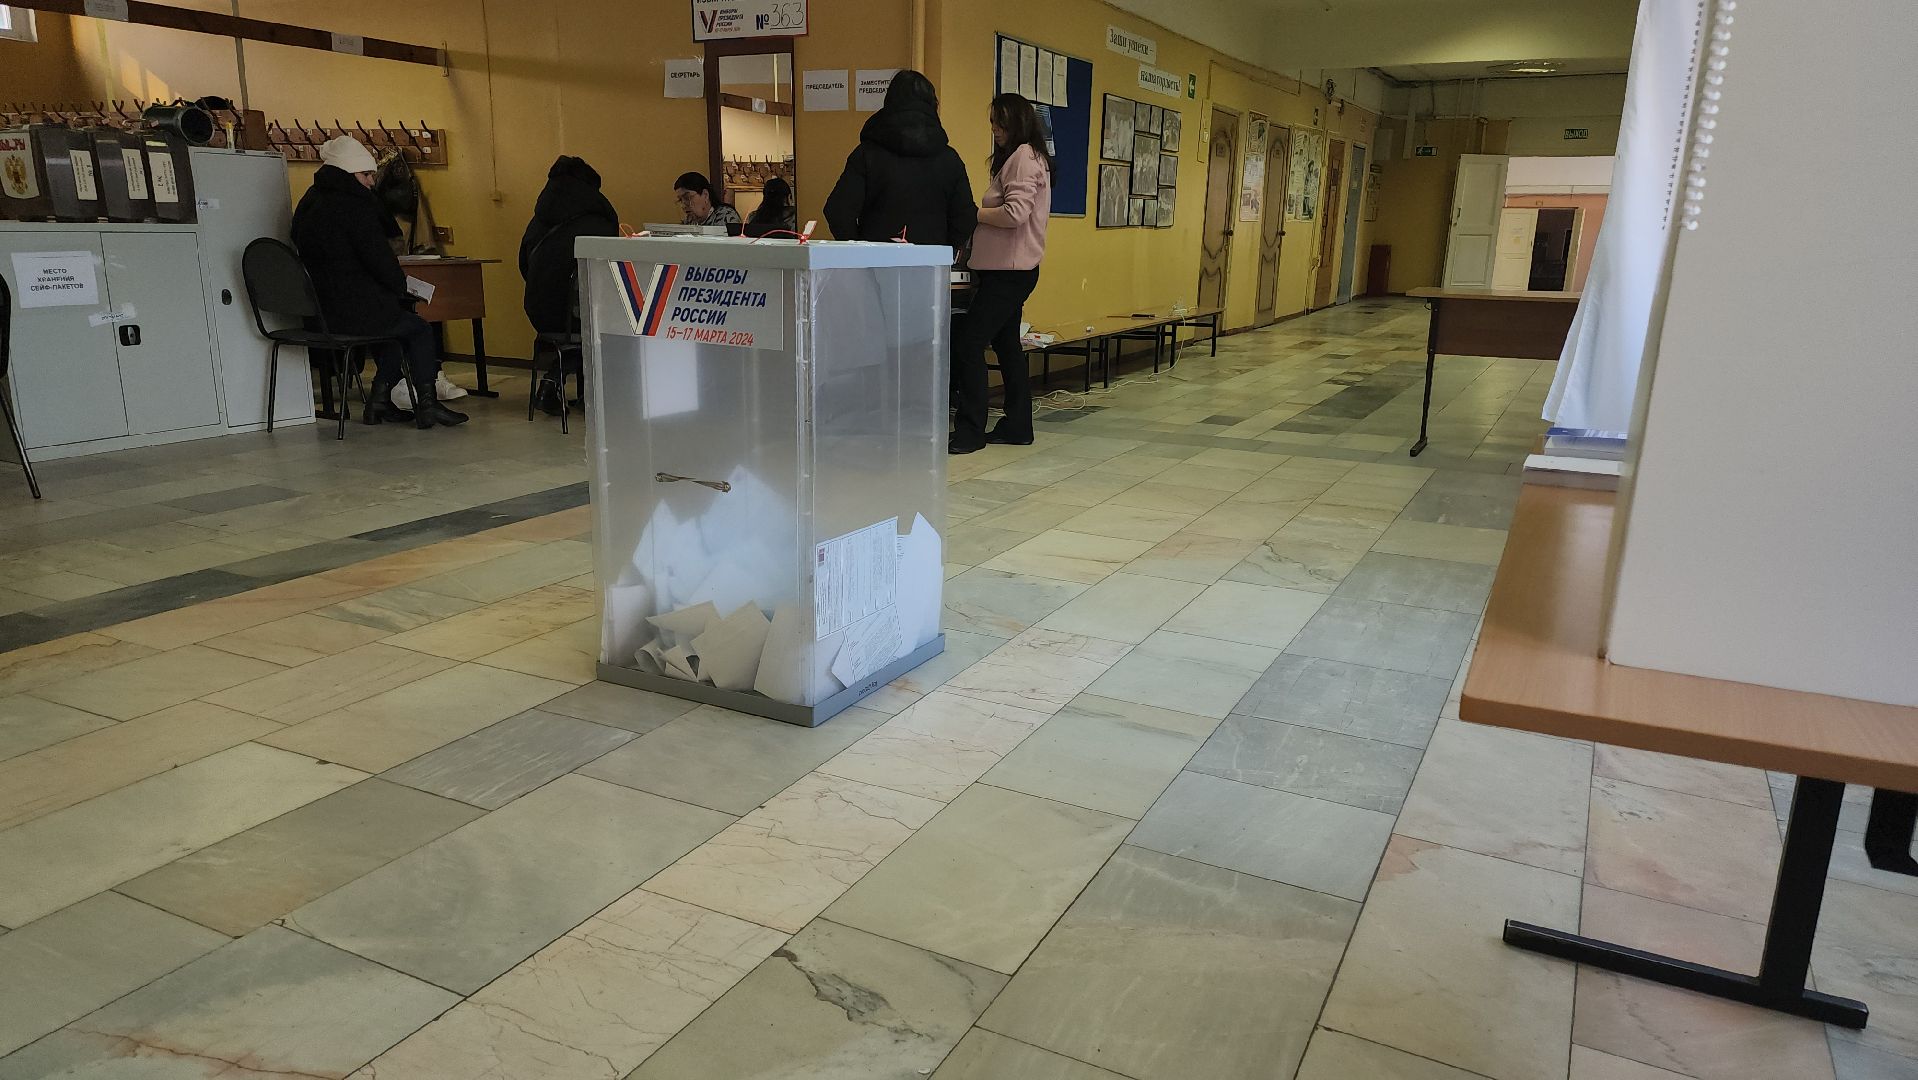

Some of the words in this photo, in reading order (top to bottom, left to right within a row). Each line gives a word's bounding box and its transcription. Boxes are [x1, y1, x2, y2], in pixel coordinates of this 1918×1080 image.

[671, 71, 701, 79] СЕКРЕТАРЬ
[805, 83, 845, 91] ПРЕДСЕДАТЕЛЬ
[1565, 129, 1588, 139] ВЫХОД
[685, 266, 748, 285] ВЫБОРЫ
[30, 283, 85, 292] СЕЙФ-ПАКЕТОВ
[677, 287, 767, 308] ПРЕЗИДЕНТА
[671, 306, 728, 326] РОССИИ
[694, 328, 728, 344] МАРТА
[728, 332, 754, 347] 2024
